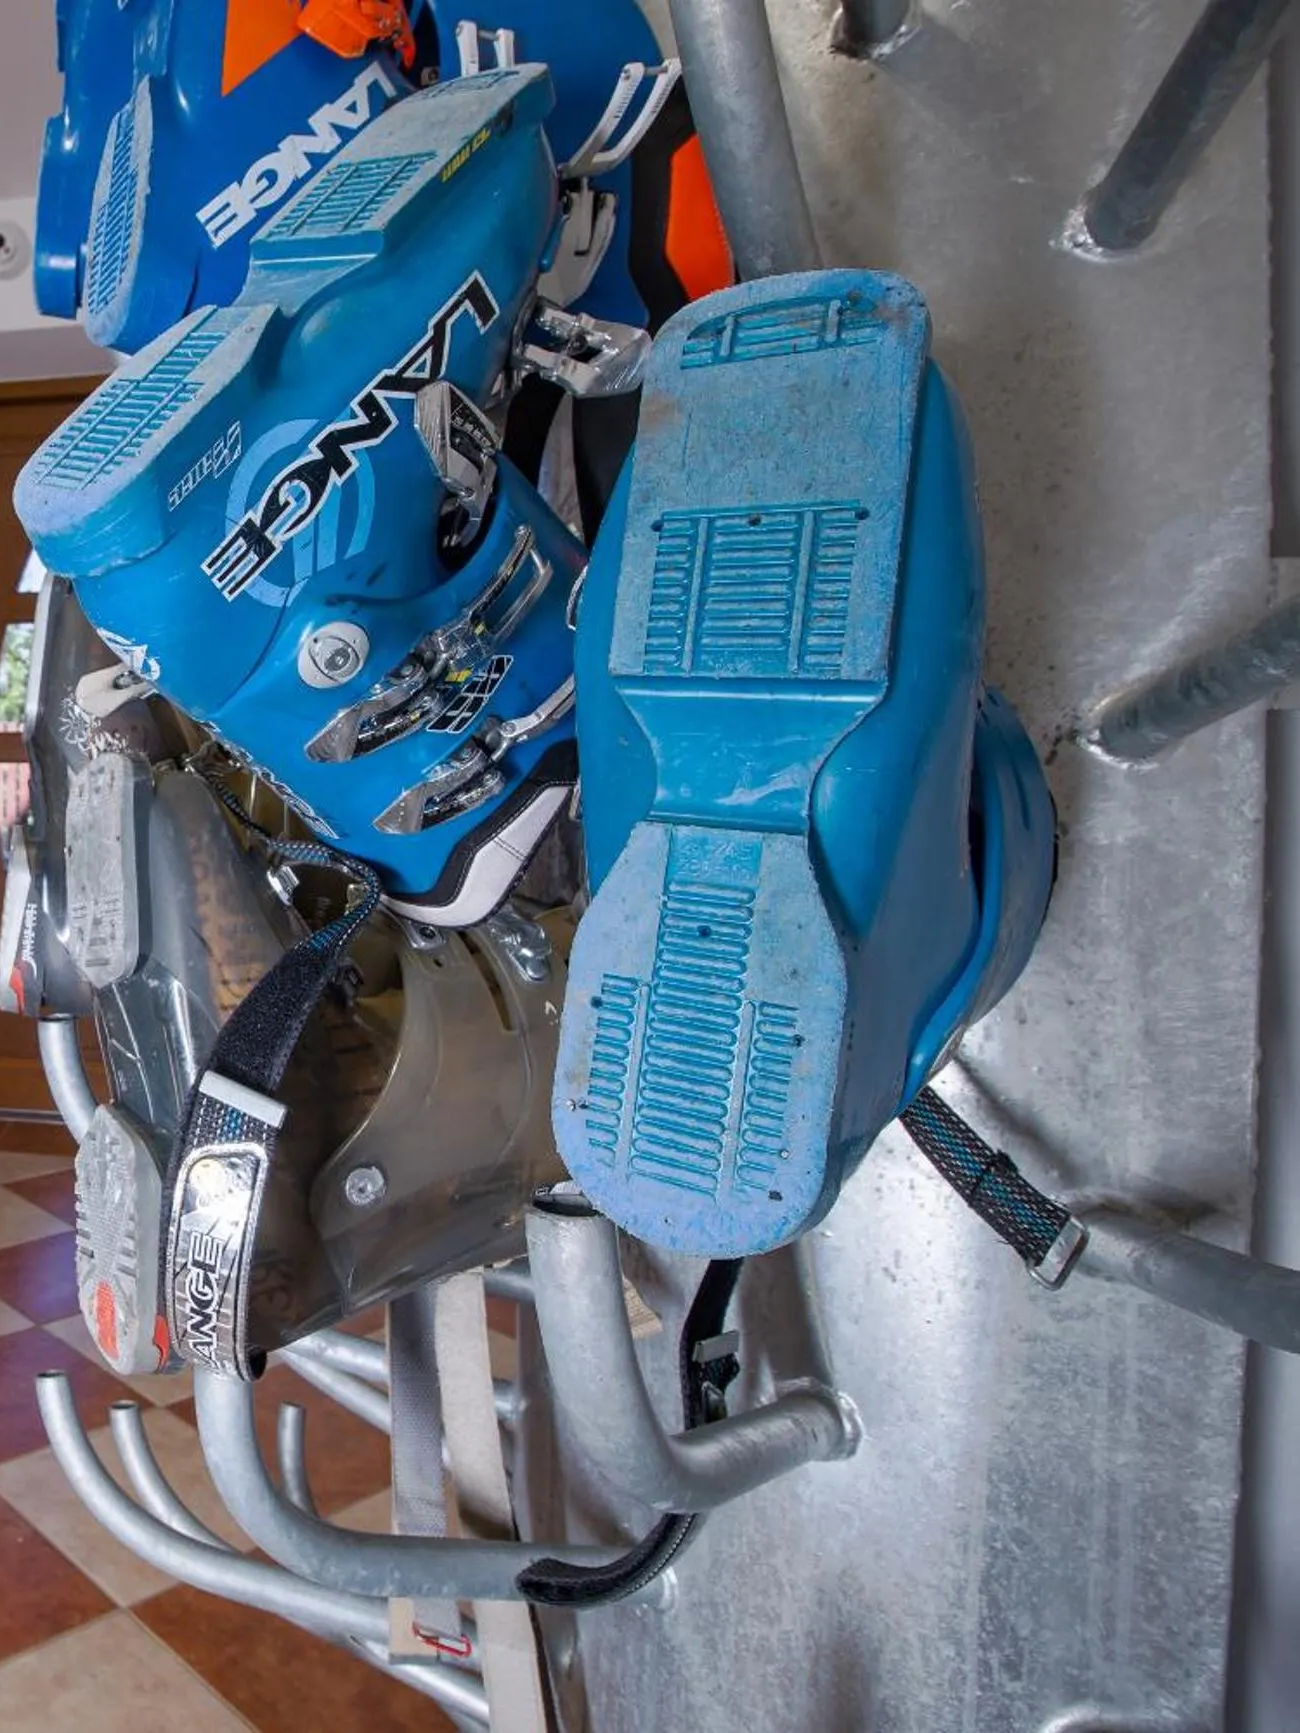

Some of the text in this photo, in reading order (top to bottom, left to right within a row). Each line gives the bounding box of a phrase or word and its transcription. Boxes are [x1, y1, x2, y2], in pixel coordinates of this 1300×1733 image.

[196, 60, 397, 250] LANGE
[200, 269, 500, 602] LANGE
[185, 1231, 226, 1372] ANGE
